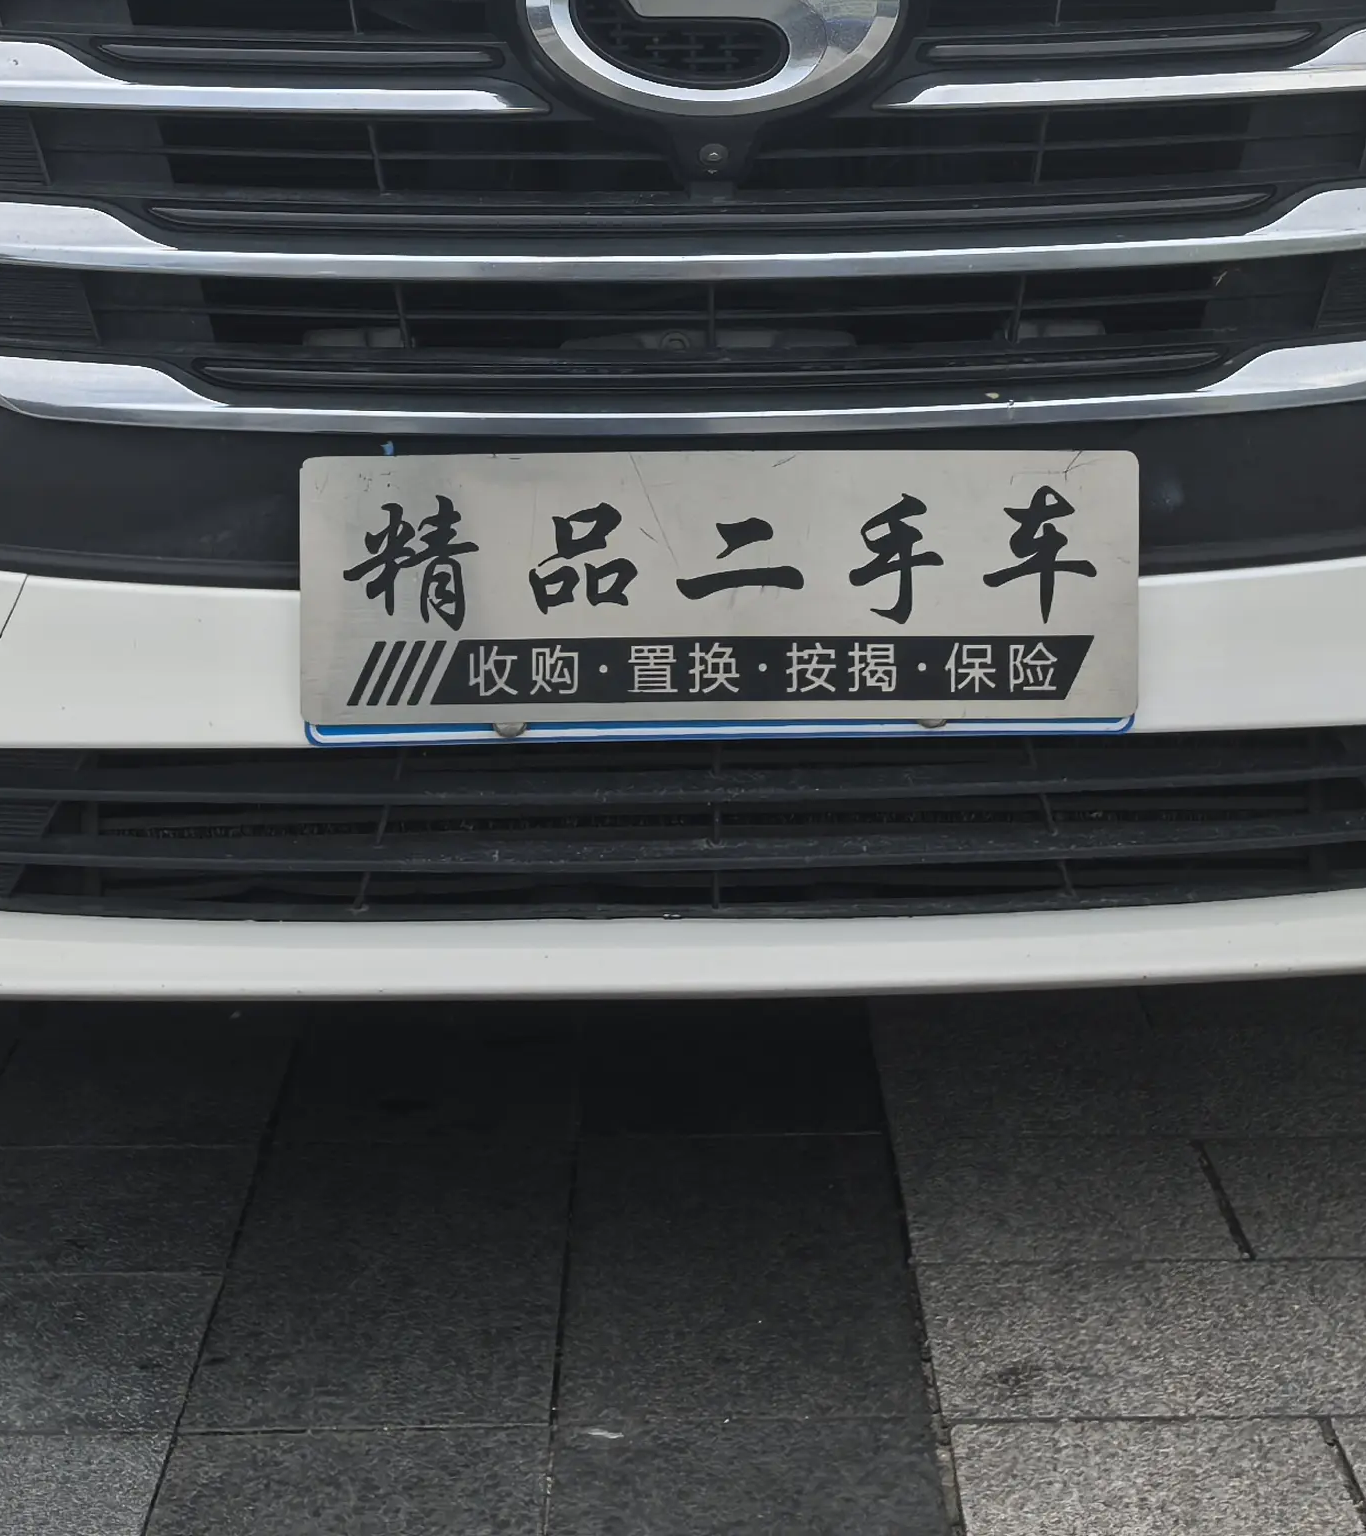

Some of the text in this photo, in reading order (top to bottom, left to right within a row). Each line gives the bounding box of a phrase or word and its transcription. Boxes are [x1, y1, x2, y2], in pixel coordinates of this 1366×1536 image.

[343, 484, 1097, 631] 精品二手车
